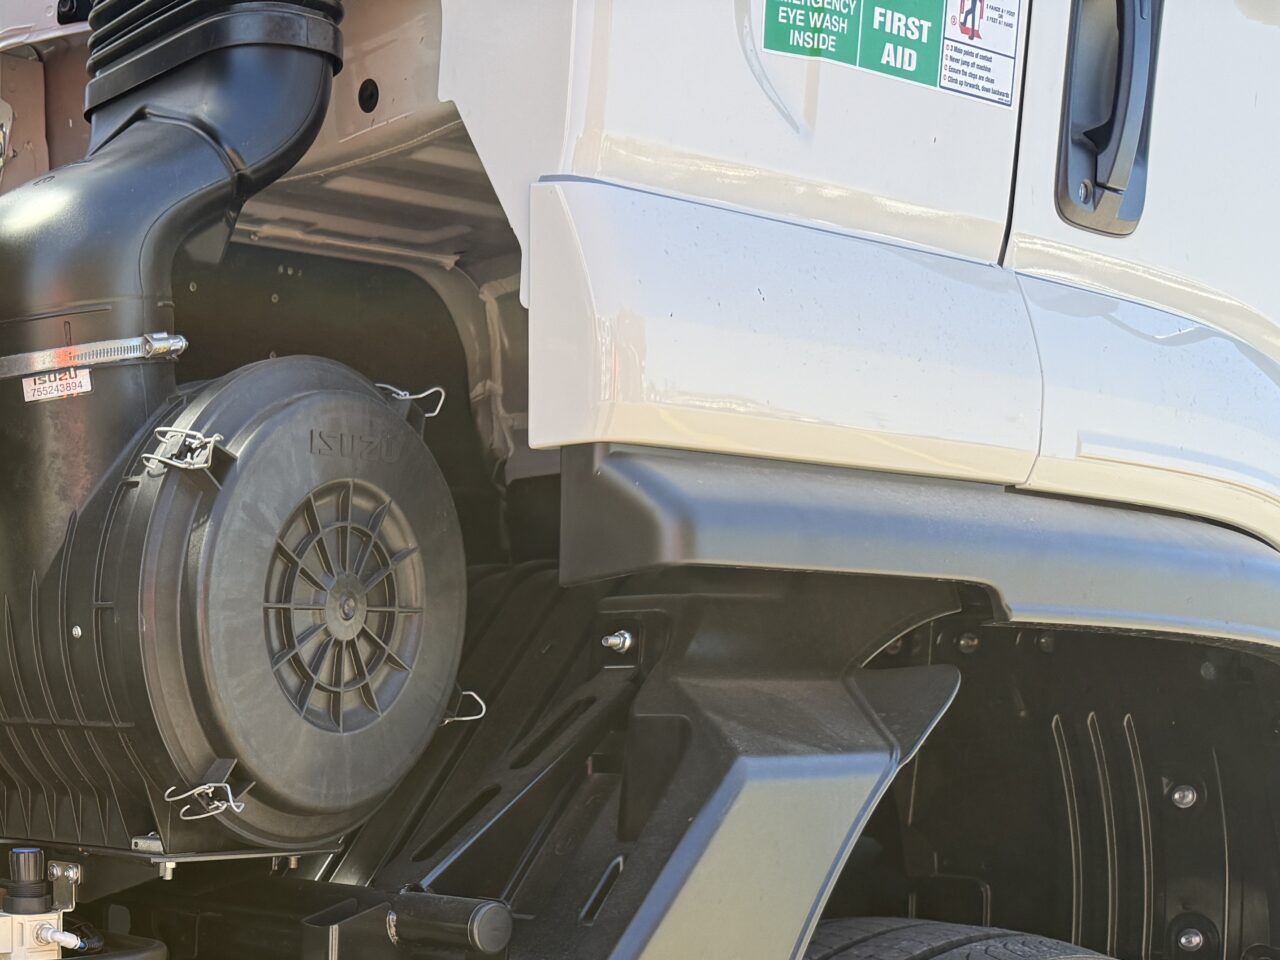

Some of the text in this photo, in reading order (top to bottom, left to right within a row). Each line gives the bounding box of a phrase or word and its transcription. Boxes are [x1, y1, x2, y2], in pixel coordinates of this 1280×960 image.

[778, 6, 848, 34] EYE WASH
[873, 6, 932, 43] FIRST
[789, 29, 837, 52] INSIDE
[880, 42, 918, 72] AID
[949, 55, 960, 64] Never
[976, 63, 991, 73] machine
[947, 75, 958, 84] Climb
[948, 65, 961, 75] Ensure
[33, 368, 77, 385] ISUZU
[32, 381, 83, 397] 755243894
[309, 429, 402, 463] ISUZU
